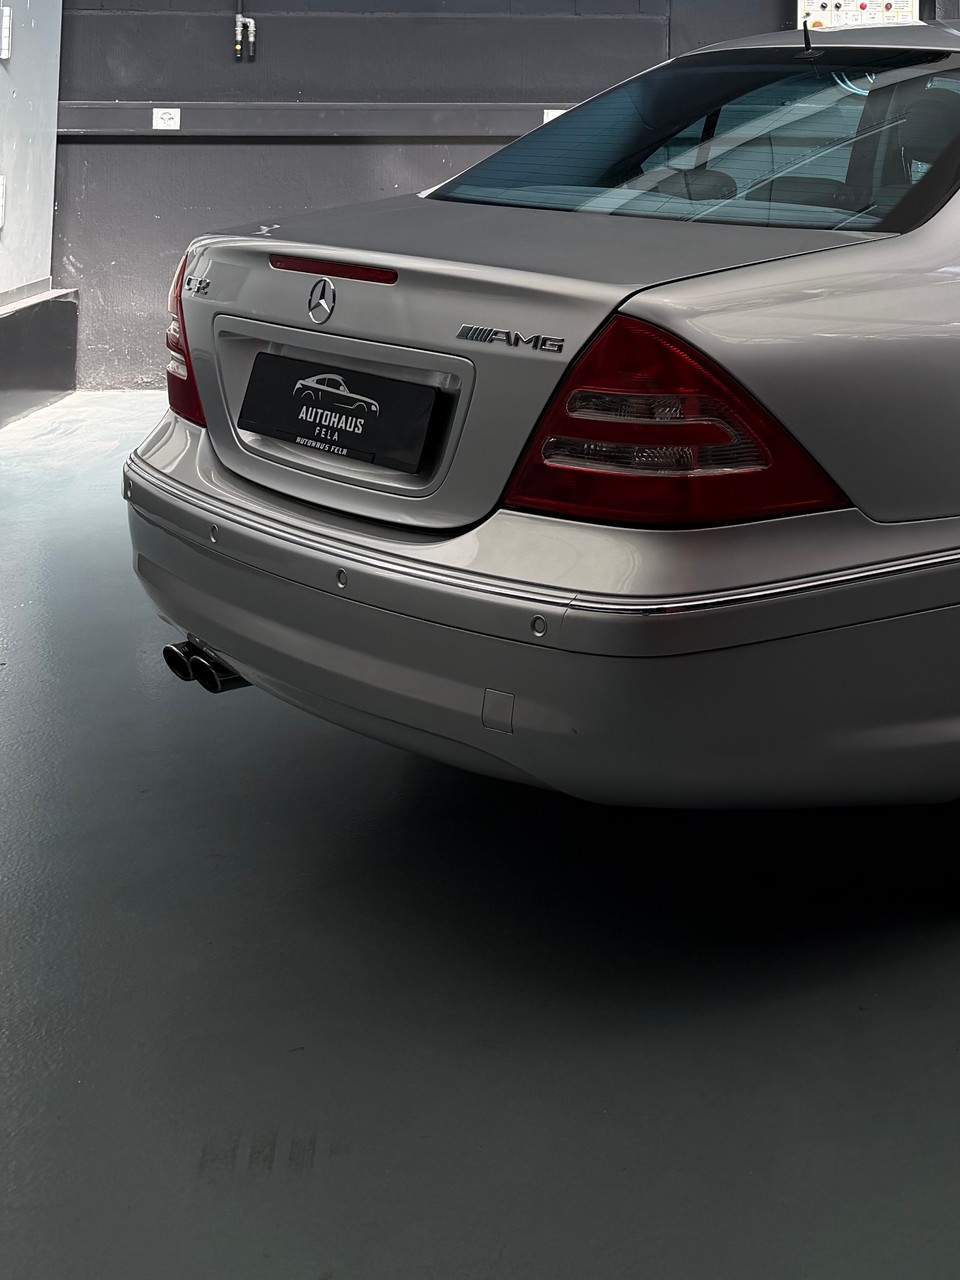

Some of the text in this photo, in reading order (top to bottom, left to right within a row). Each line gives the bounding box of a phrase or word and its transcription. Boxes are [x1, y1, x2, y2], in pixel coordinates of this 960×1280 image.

[487, 328, 565, 353] AMG
[298, 405, 365, 434] AUTOHAUS
[315, 427, 338, 441] FELA
[296, 437, 347, 455] AUTOHAUS FELA
